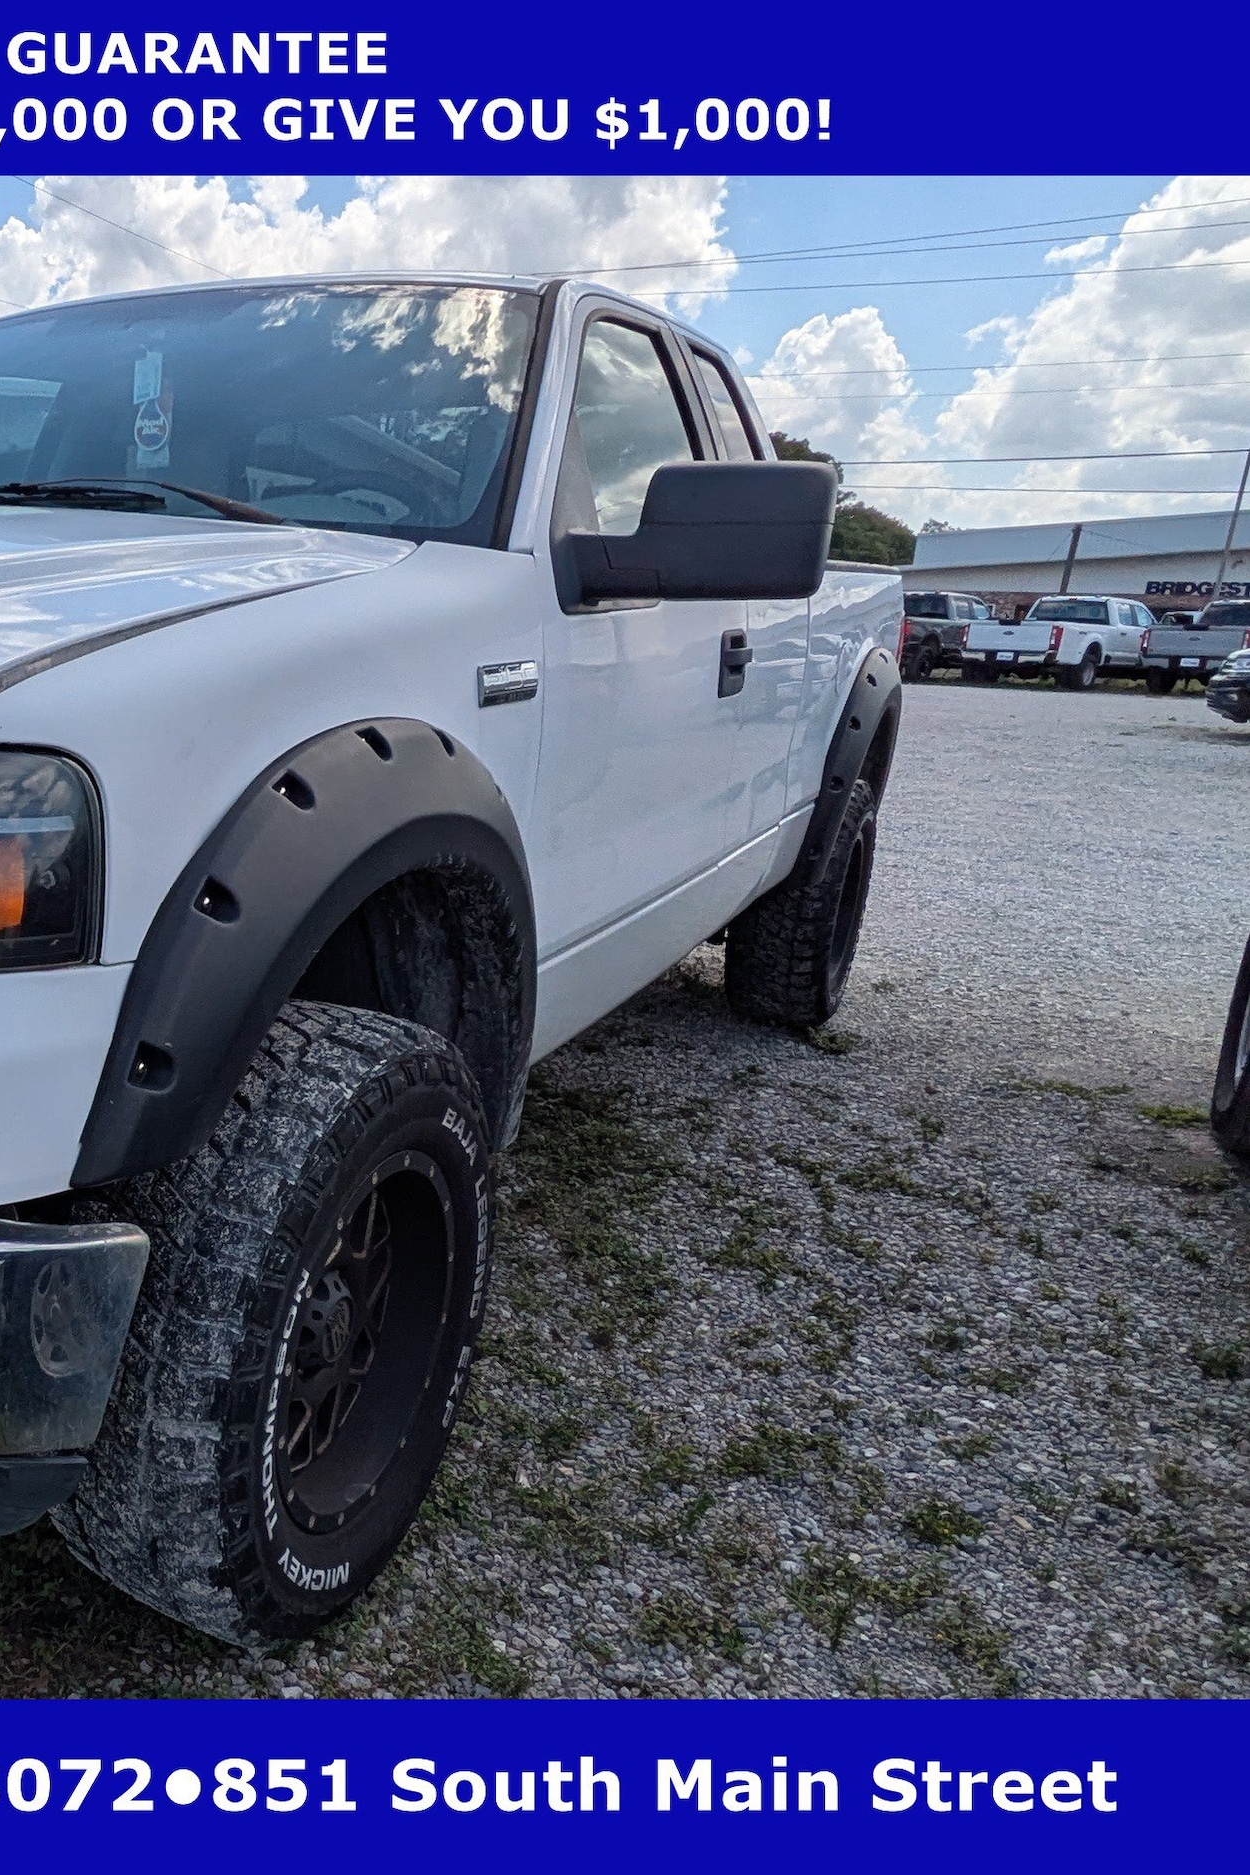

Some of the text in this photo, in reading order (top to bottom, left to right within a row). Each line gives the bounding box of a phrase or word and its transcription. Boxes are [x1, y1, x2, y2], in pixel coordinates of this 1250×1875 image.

[441, 1107, 488, 1428] BAJA LEGEND EXP
[262, 1268, 350, 1591] MICKEY THOMPSON
